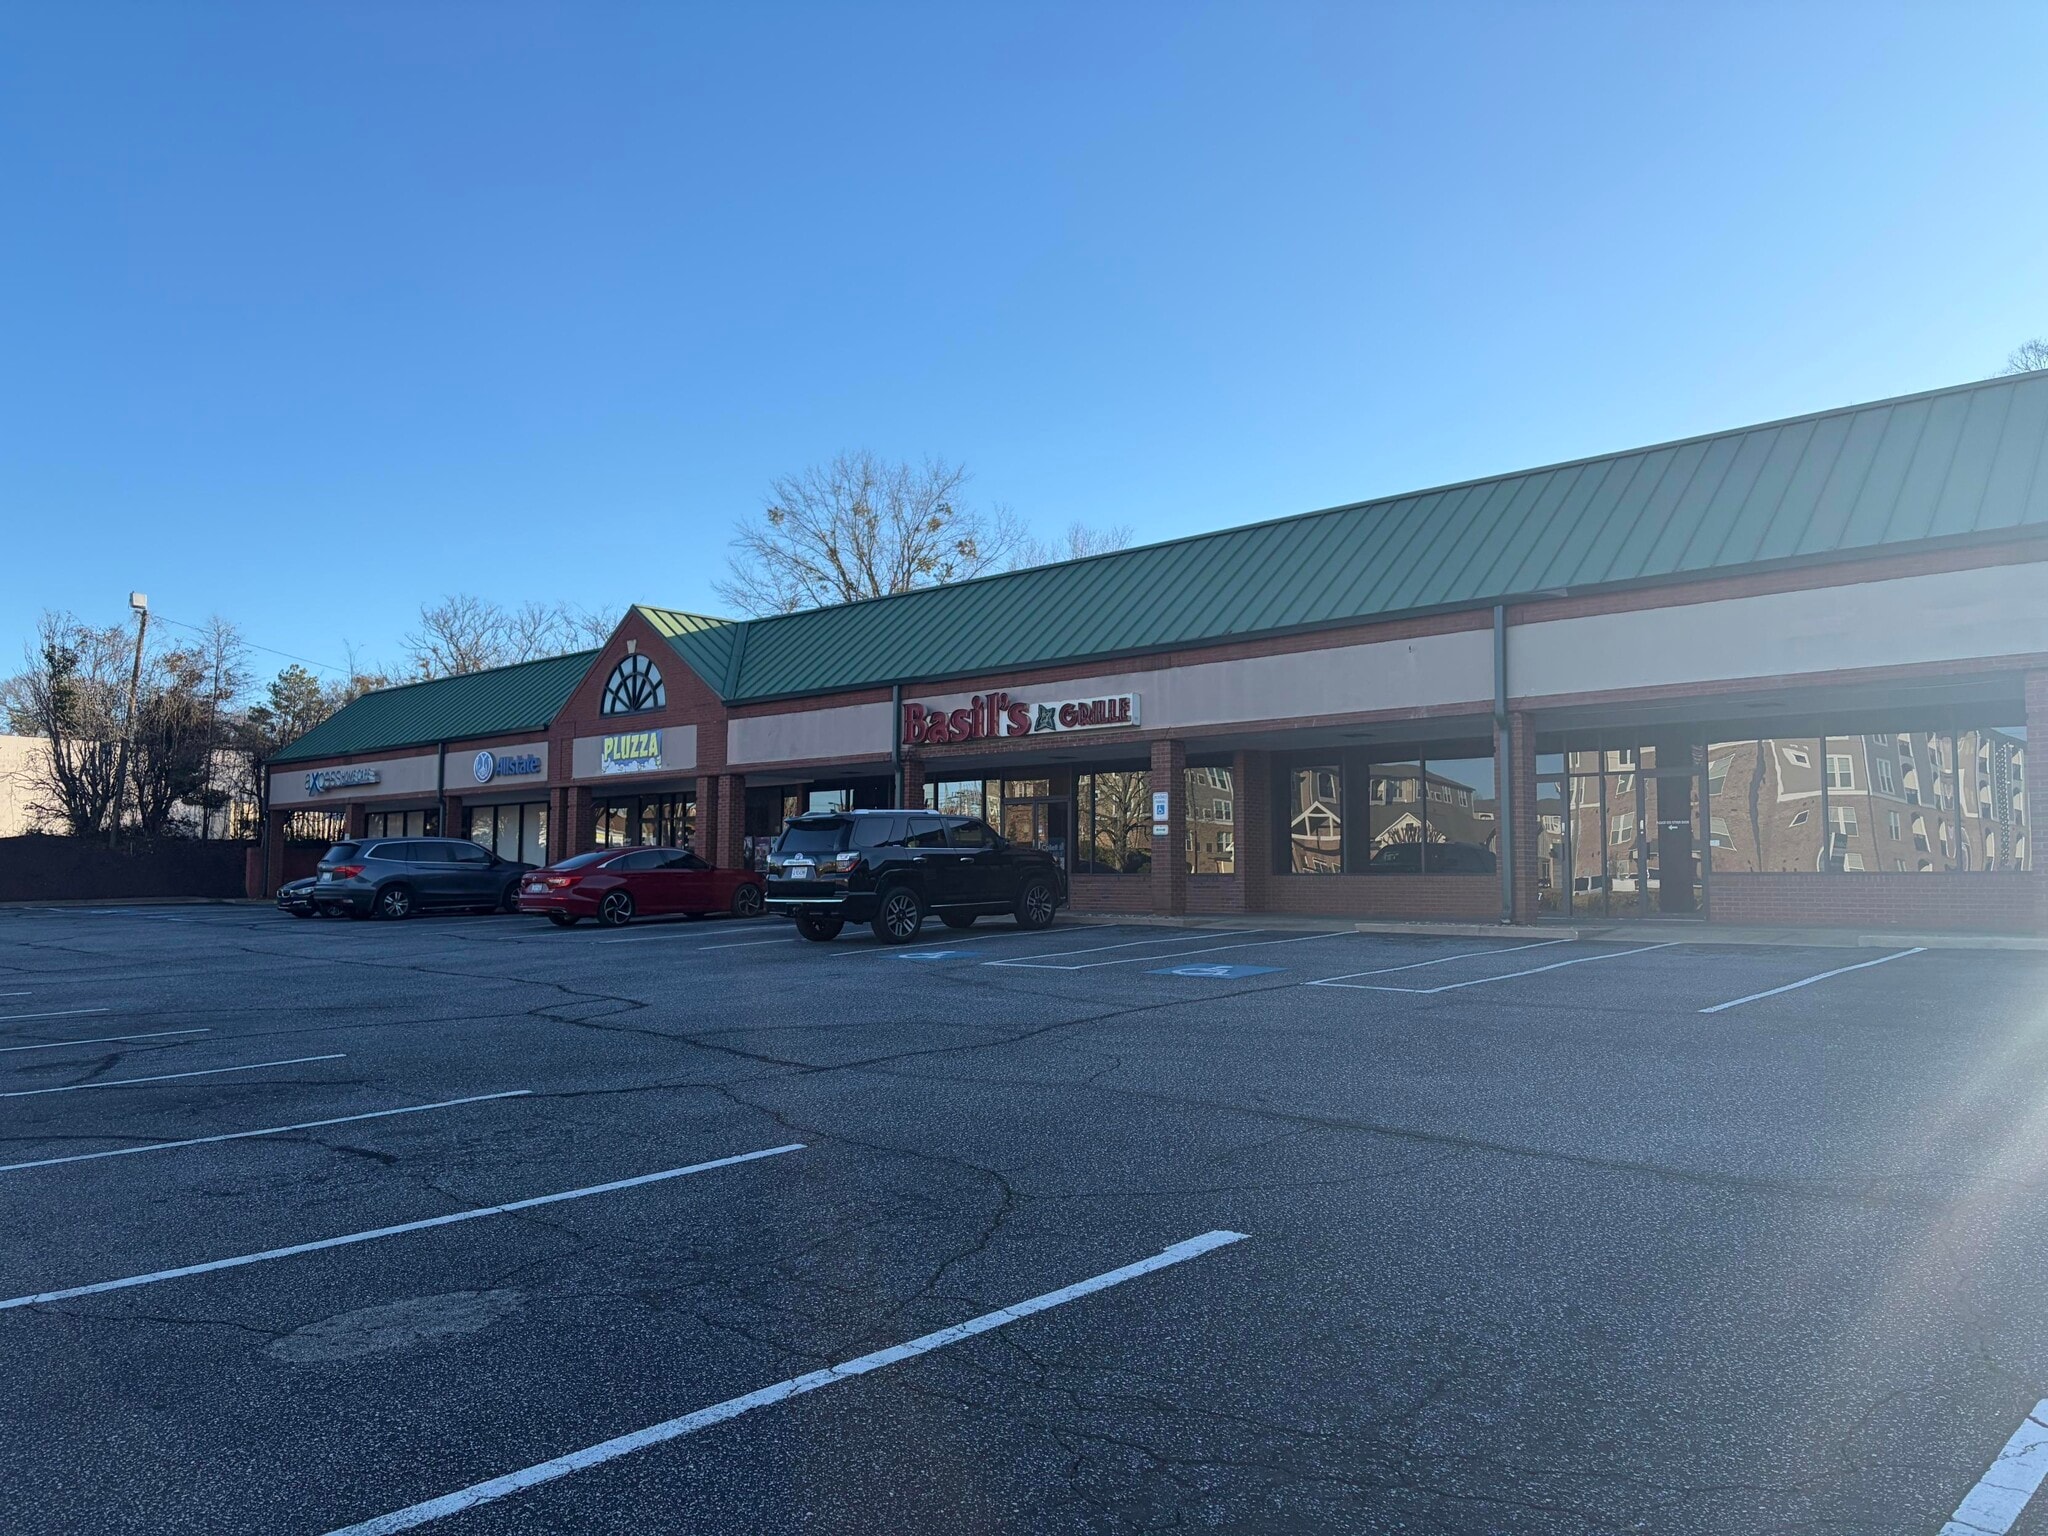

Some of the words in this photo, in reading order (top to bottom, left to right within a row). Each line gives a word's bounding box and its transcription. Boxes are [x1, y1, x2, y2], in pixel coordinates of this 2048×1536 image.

[902, 692, 1031, 744] Basil's
[1058, 697, 1132, 727] GRILLE
[604, 732, 659, 761] PLUZZA
[496, 754, 541, 776] Allstate
